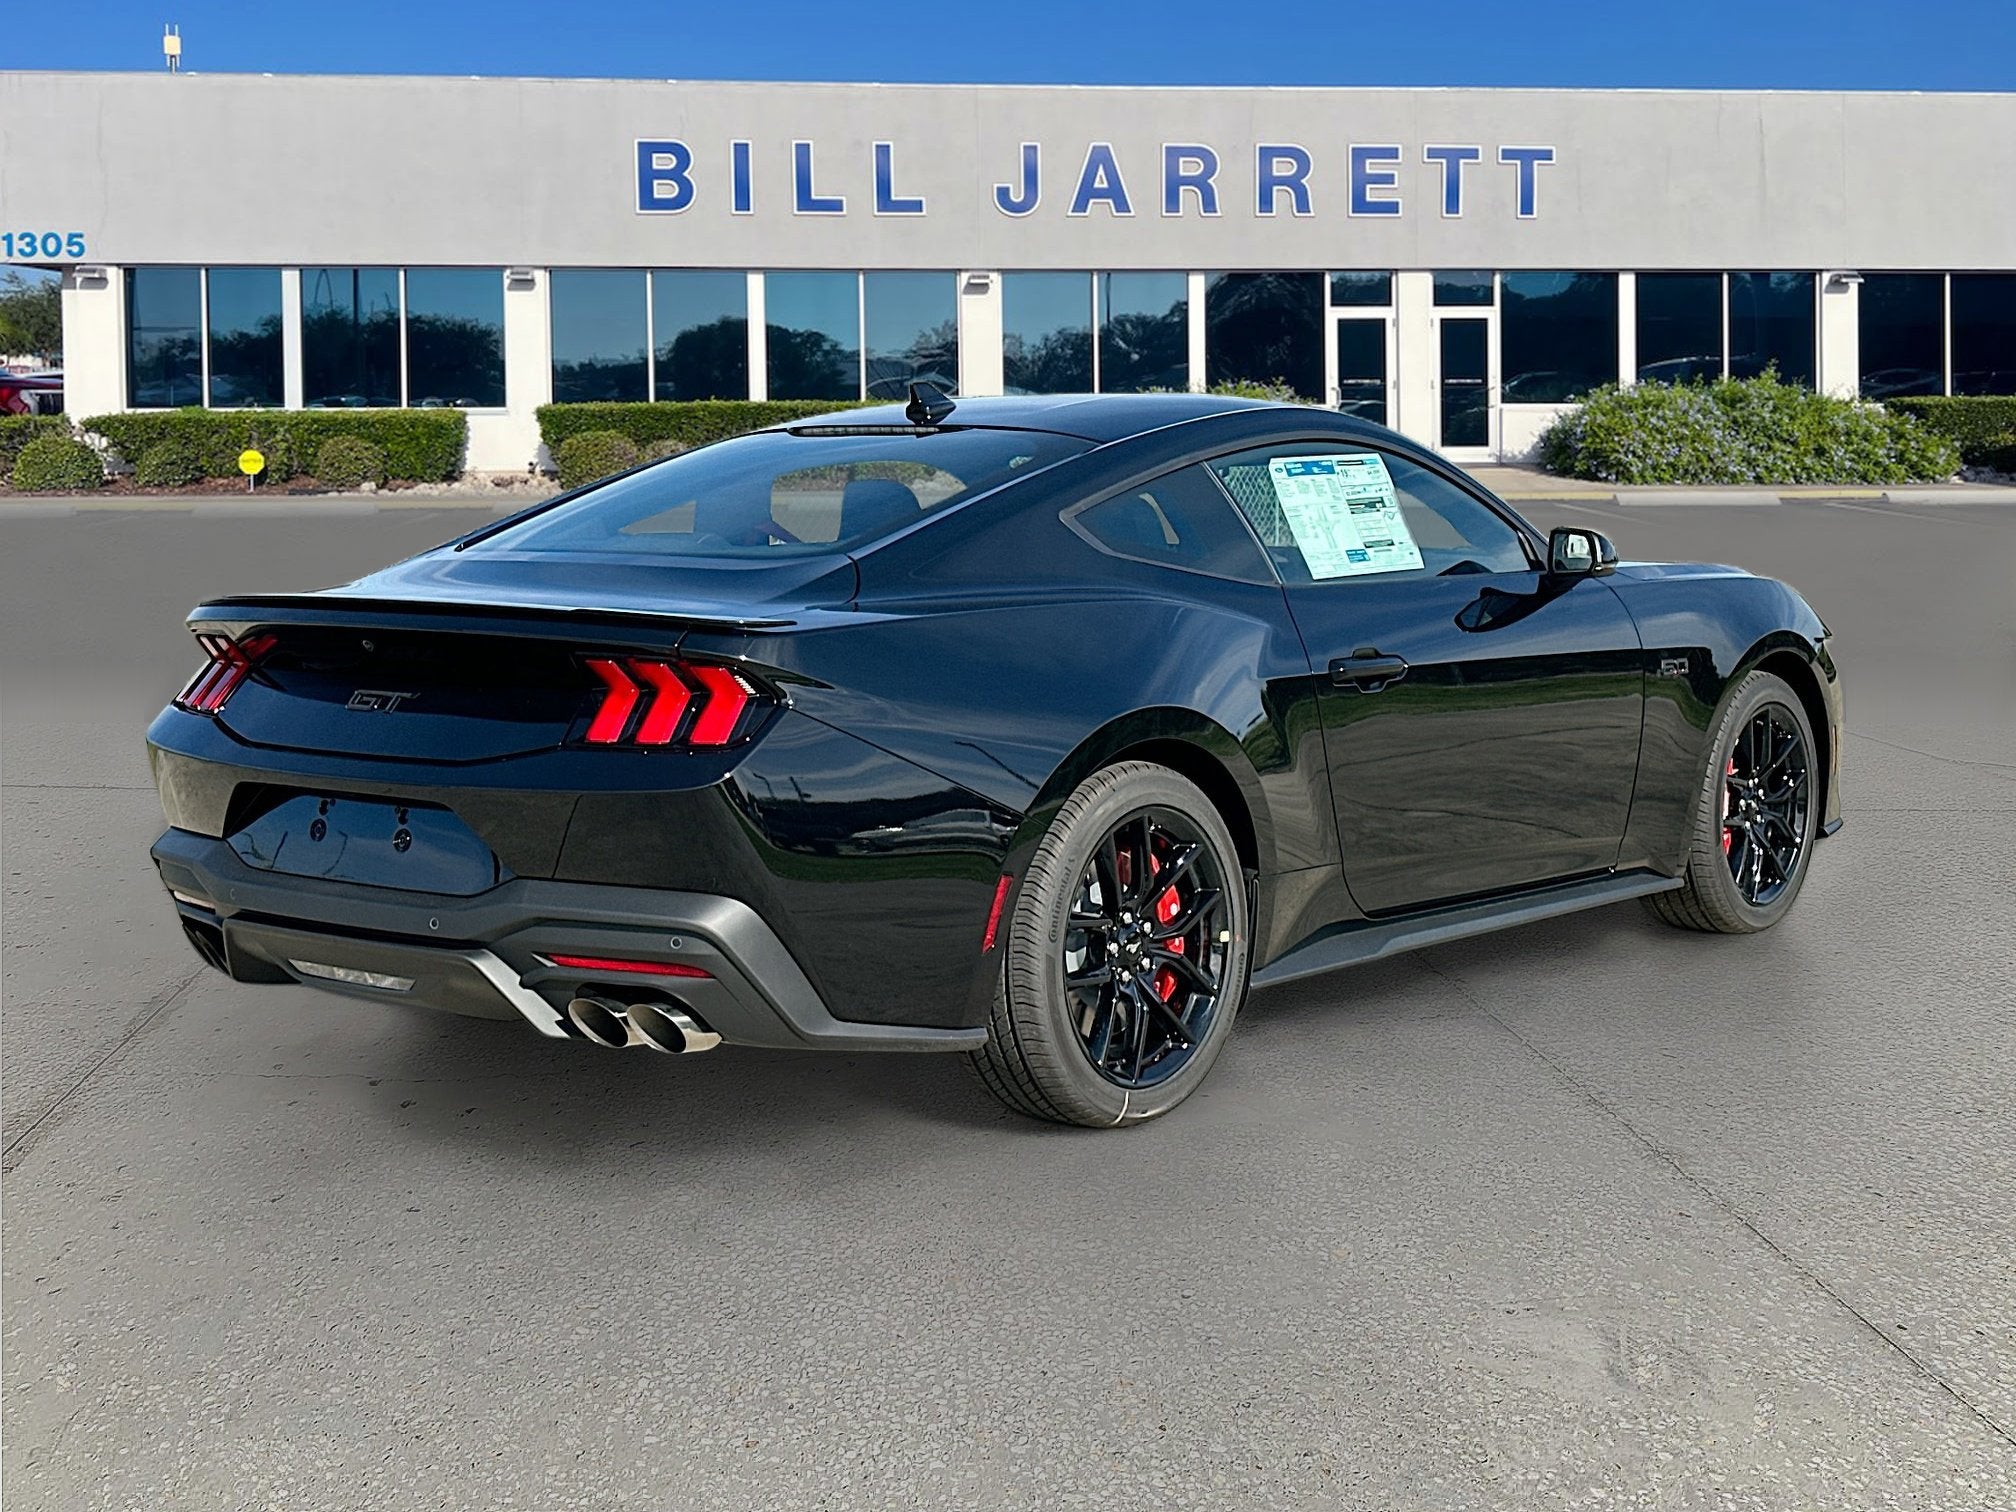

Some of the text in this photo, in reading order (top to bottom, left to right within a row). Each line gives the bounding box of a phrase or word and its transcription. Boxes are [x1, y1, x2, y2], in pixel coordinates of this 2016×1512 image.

[635, 138, 1555, 219] BILL JARRETT
[1, 231, 86, 258] 1305
[345, 689, 420, 713] GT
